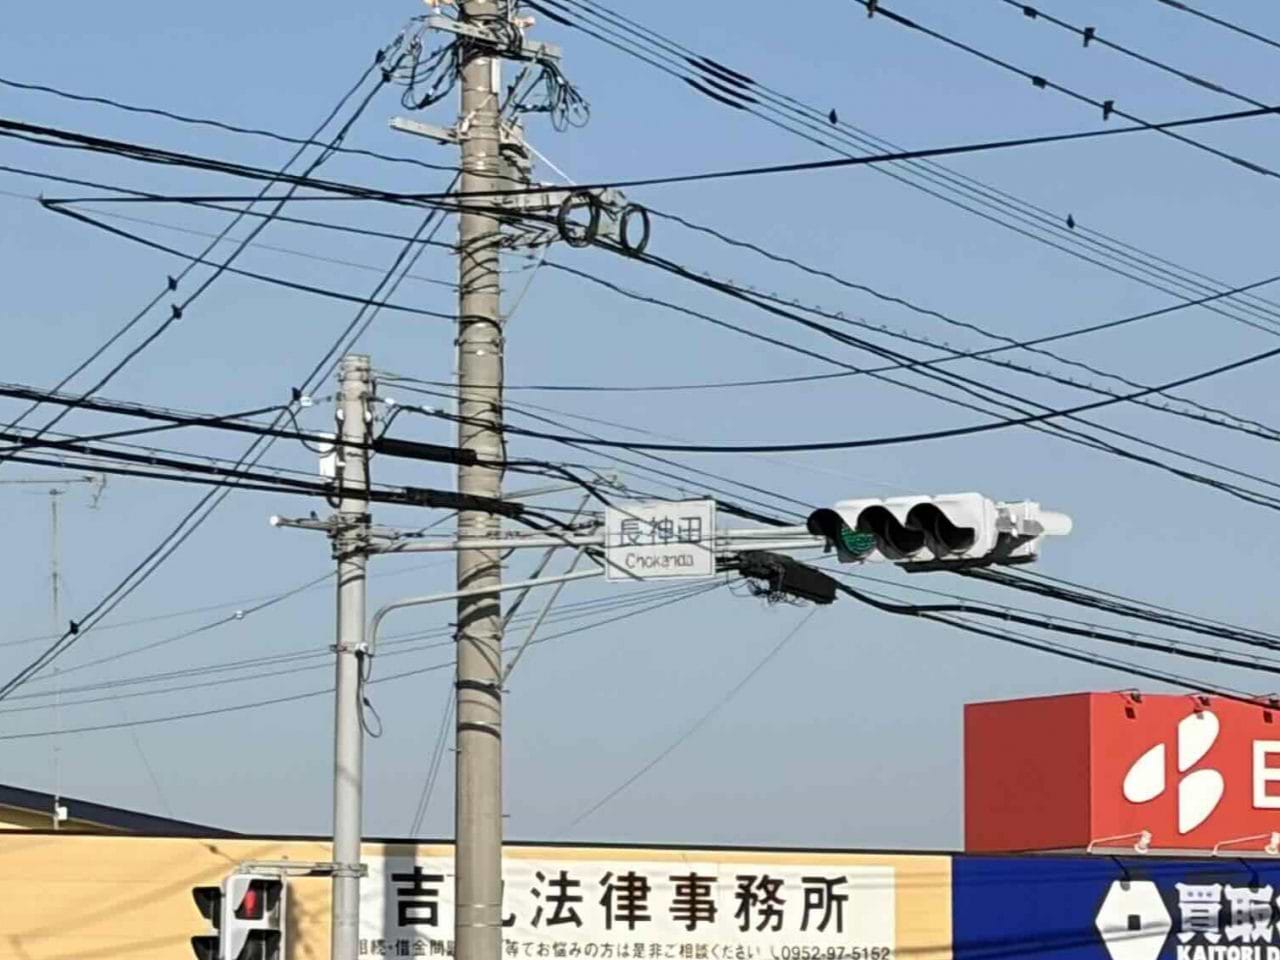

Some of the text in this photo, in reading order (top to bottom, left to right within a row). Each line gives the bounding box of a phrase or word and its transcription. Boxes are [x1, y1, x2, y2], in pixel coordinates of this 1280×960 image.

[620, 515, 702, 546] 長神田
[391, 866, 849, 933] 吉法律事務所
